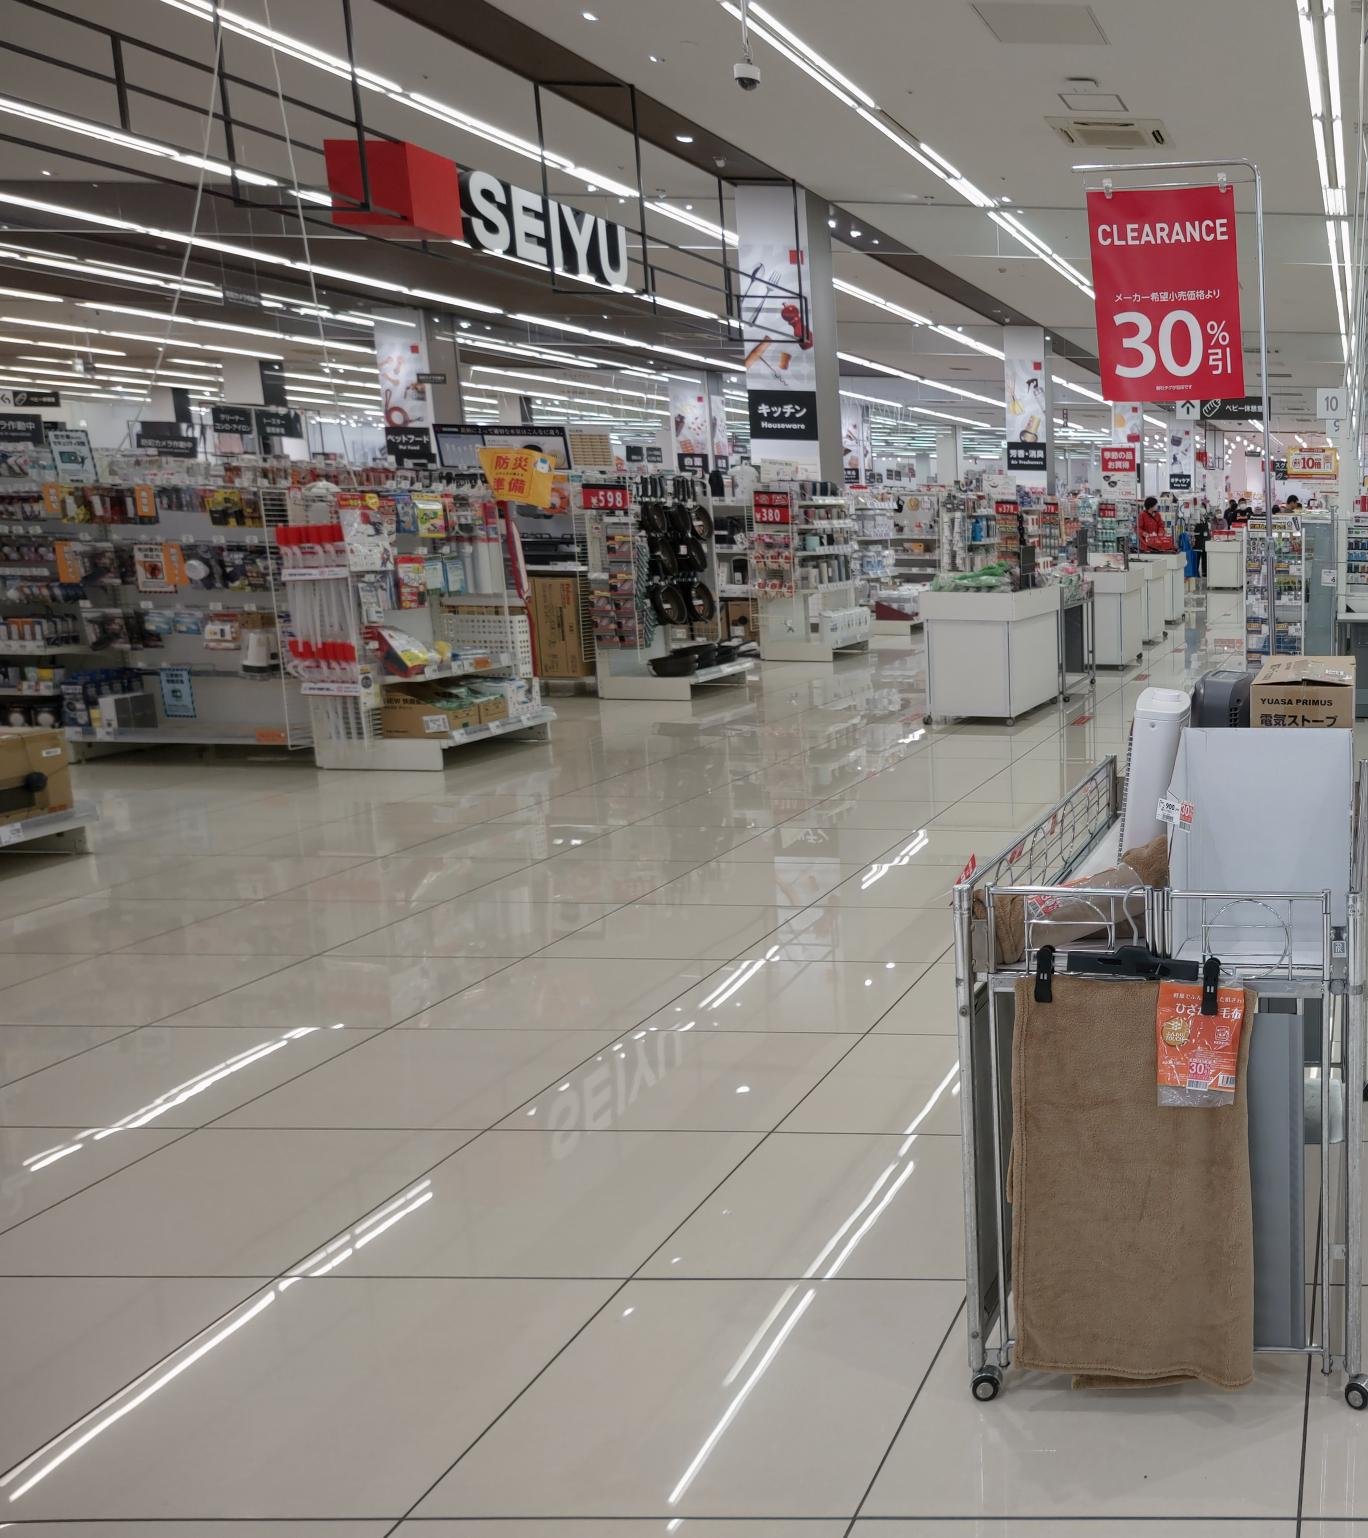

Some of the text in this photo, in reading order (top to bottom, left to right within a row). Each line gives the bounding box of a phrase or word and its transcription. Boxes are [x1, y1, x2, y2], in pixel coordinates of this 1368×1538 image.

[469, 171, 628, 286] SEIYU
[1097, 218, 1229, 246] CLEARANCE
[1114, 289, 1221, 304] メーカー希望小売価格より
[757, 404, 807, 418] キッチン
[1325, 396, 1339, 411] 10
[761, 421, 805, 430] Houseware
[387, 433, 430, 444] ペットフード
[1009, 449, 1044, 459] 芳香・消臭
[495, 455, 529, 471] 防災
[493, 477, 526, 494] 準備
[1260, 713, 1338, 727] 電気ストーブ
[1175, 1003, 1242, 1020] ひざ毛布
